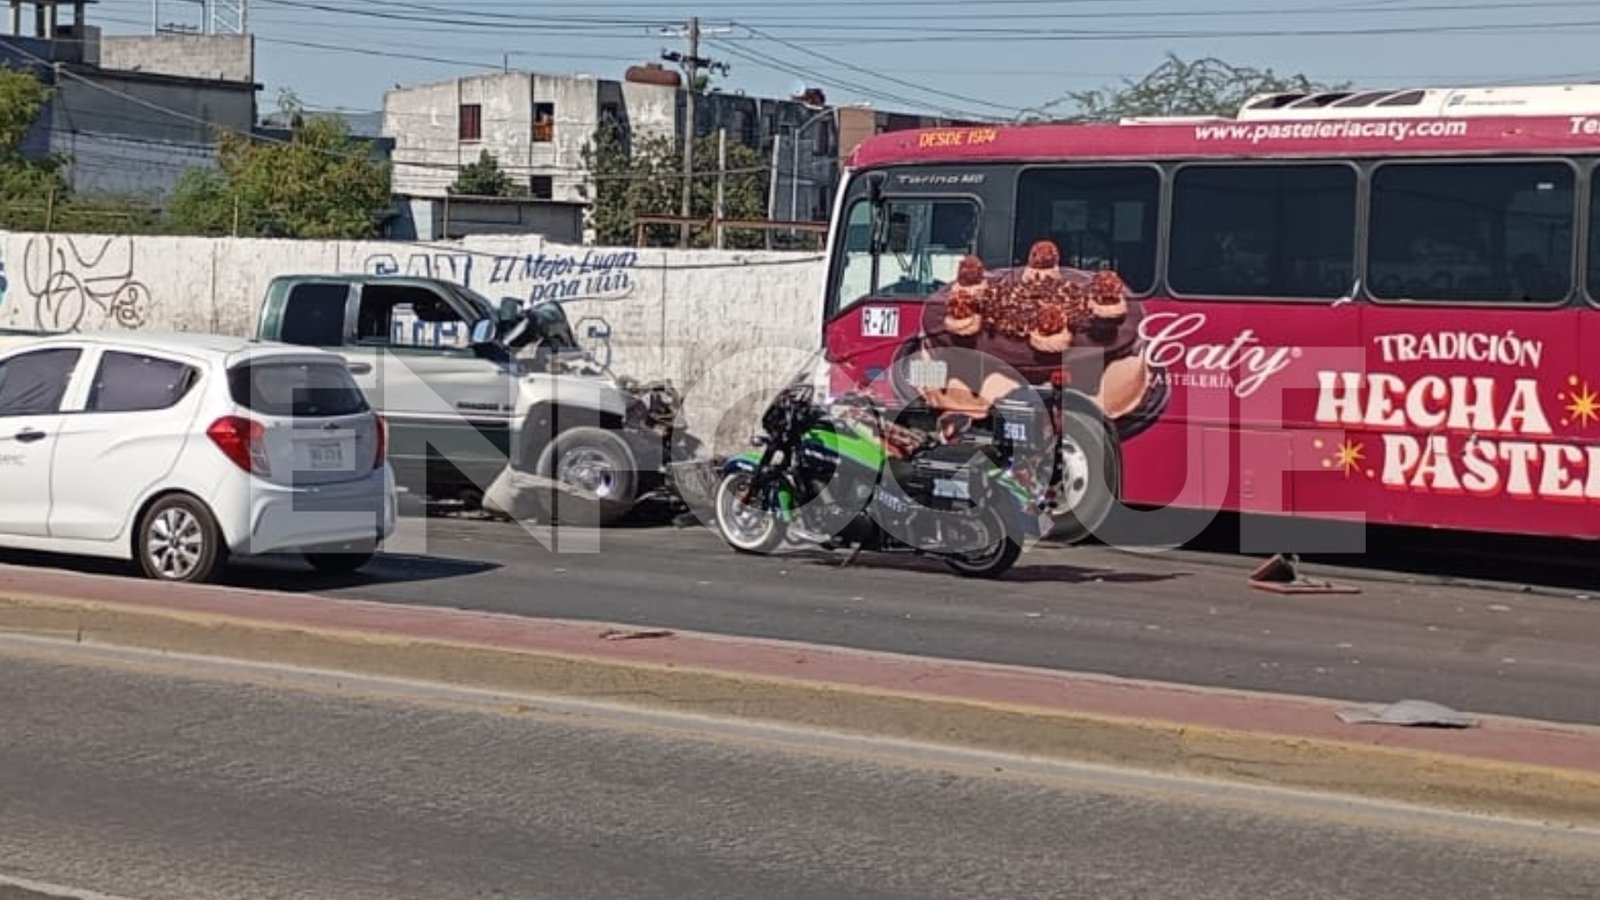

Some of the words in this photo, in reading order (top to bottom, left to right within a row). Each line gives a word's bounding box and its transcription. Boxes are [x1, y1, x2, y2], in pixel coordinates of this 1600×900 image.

[919, 132, 963, 149] DESDE
[1195, 119, 1467, 144] www.pasteleriacaty.com
[520, 252, 576, 282] Mejor
[578, 249, 638, 275] Lugar
[530, 278, 582, 303] para
[1138, 311, 1291, 398] Caty
[1373, 330, 1542, 368] TRADICIÓN
[1315, 370, 1553, 434] HECHA
